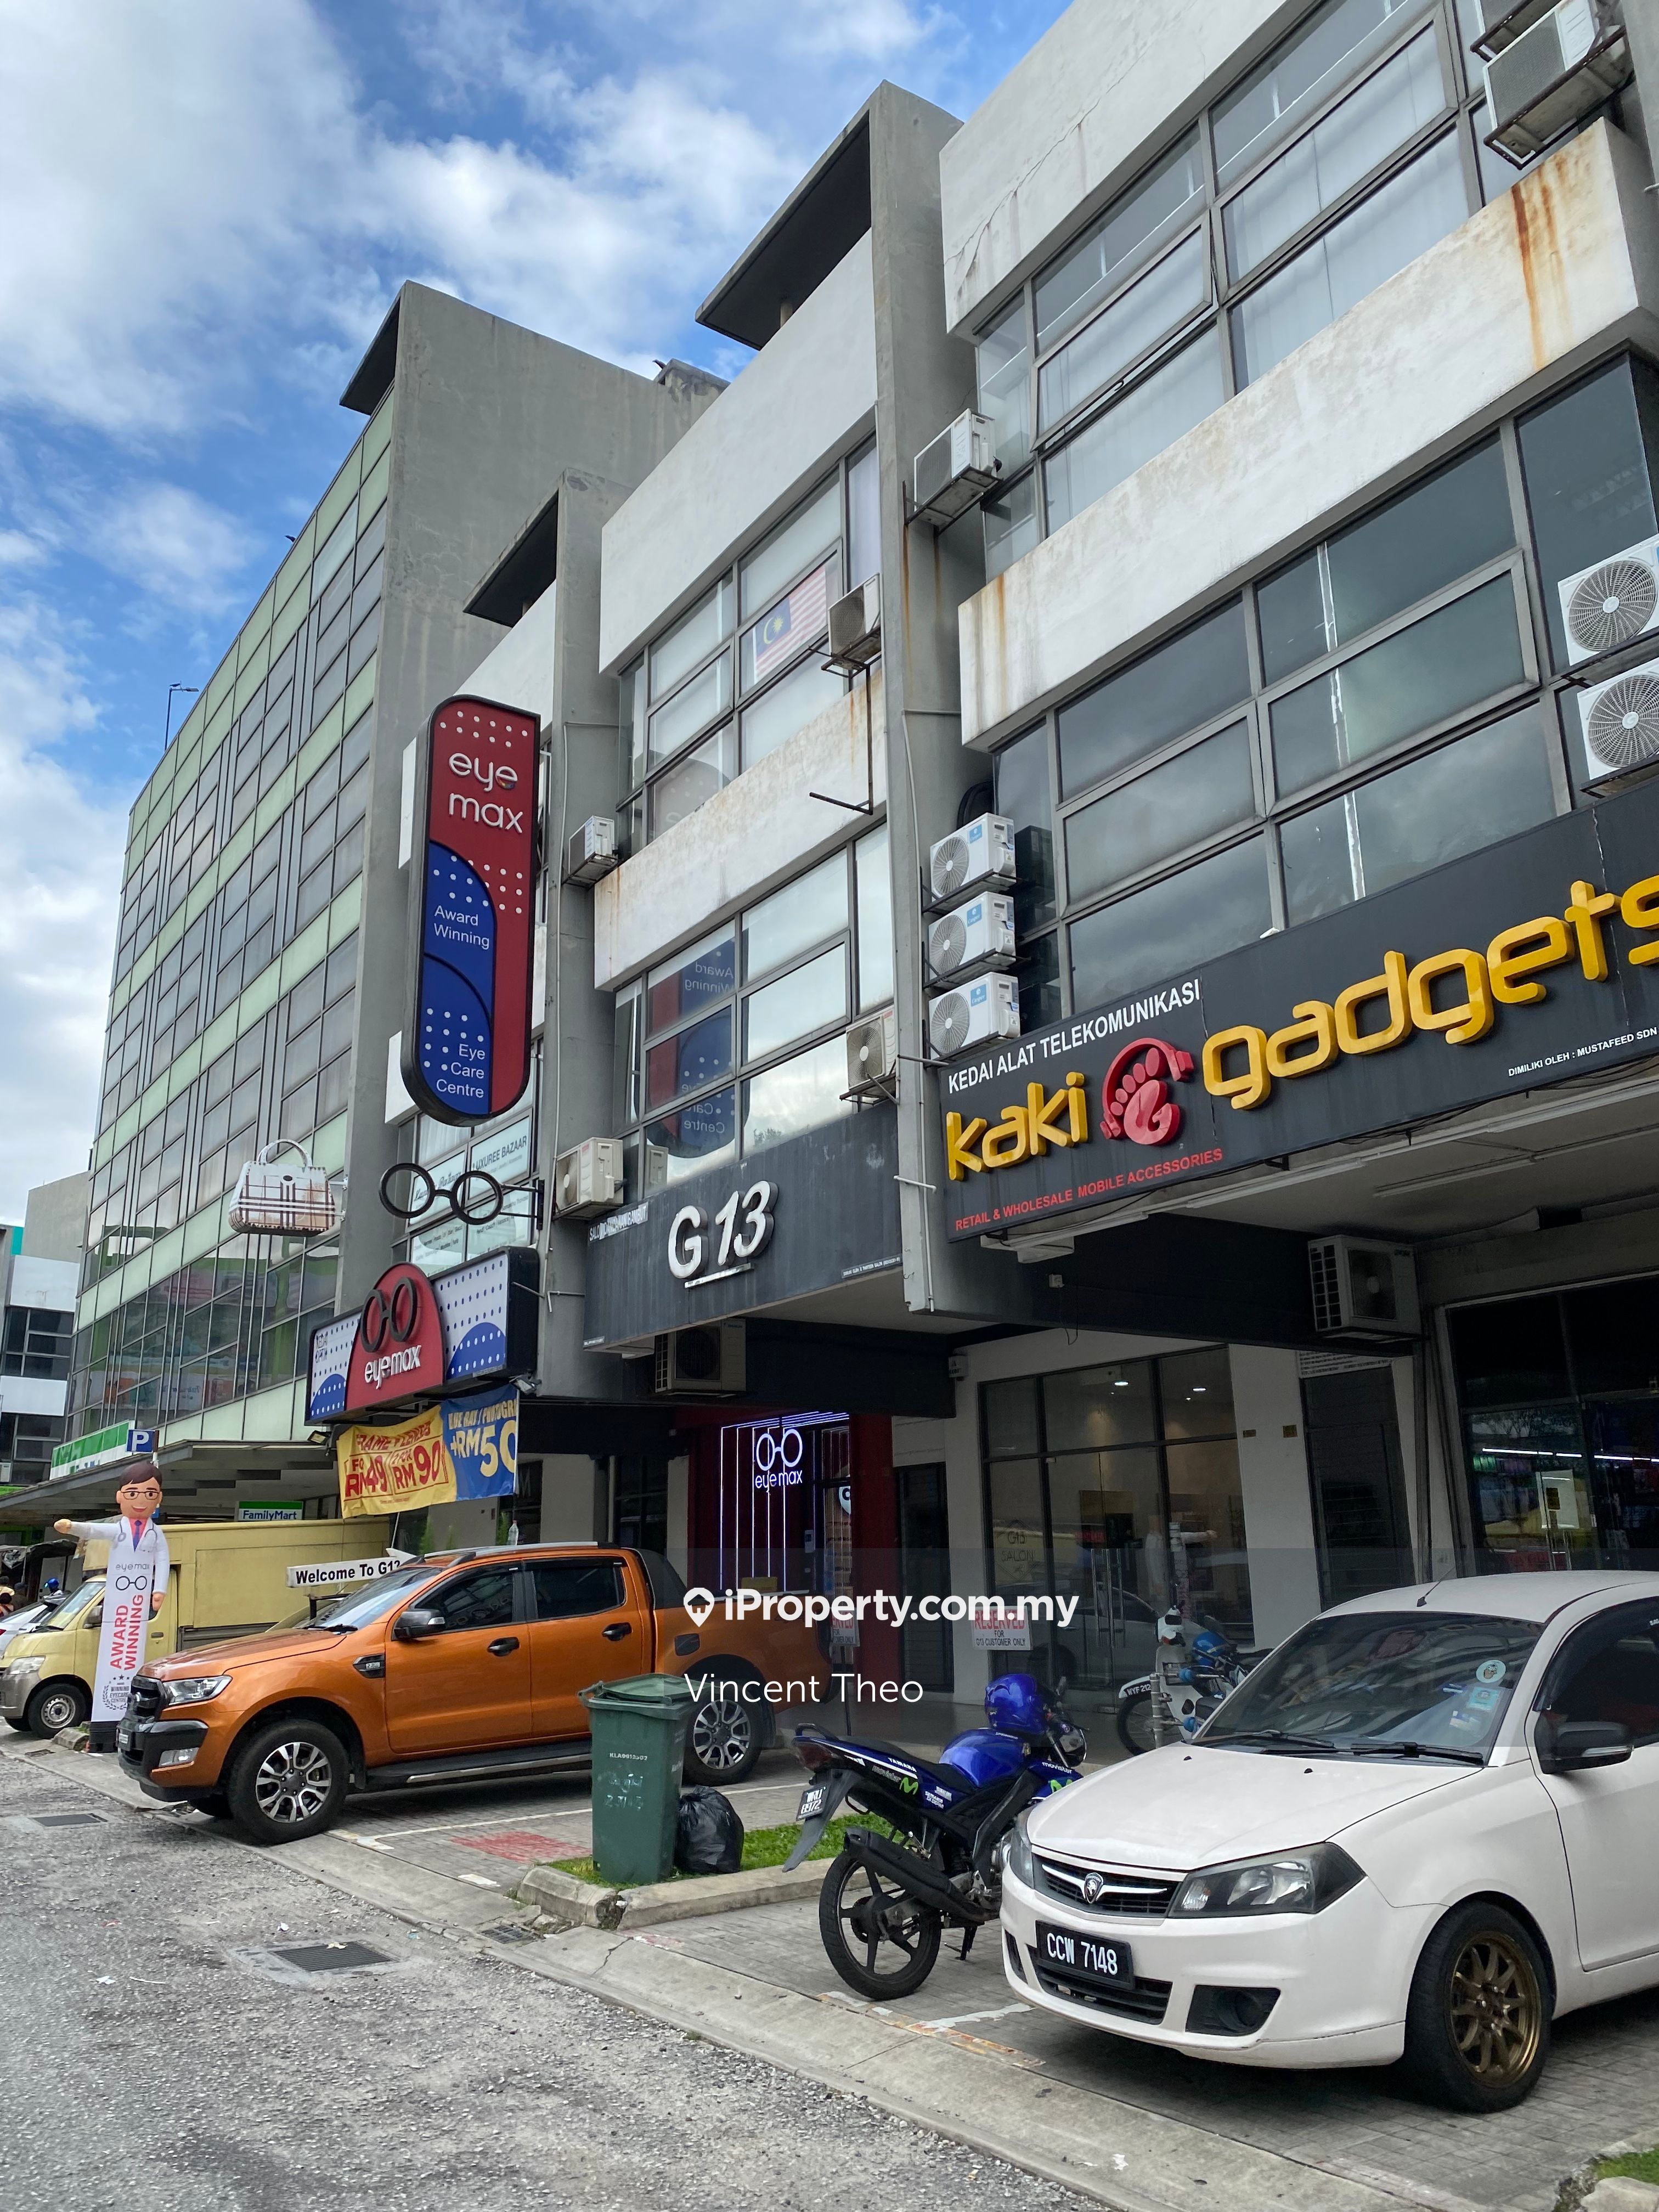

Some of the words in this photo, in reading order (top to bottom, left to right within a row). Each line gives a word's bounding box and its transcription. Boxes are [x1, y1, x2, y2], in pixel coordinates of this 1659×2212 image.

[449, 752, 518, 792] eye
[449, 793, 523, 833] max
[435, 905, 478, 926] Award
[434, 923, 490, 950] Winning
[949, 1059, 992, 1094] KEDAI
[996, 1042, 1036, 1076] ALAT
[1040, 979, 1200, 1059] TELEKOMUNIKASI
[459, 1043, 485, 1061] Eye
[1508, 1059, 1543, 1076] DIMILIKI
[1545, 1052, 1570, 1065] OLEH
[1577, 1034, 1634, 1058] MUSTAFEED
[1637, 1027, 1657, 1040] SDN
[451, 1062, 484, 1079] Care
[437, 1079, 484, 1098] Centre
[946, 1071, 1089, 1182] kaki
[501, 1135, 527, 1159] BAZAAR
[955, 1212, 991, 1232] RETAIL
[992, 1207, 1000, 1221] &
[1002, 1189, 1073, 1216] WHOLESALE
[1077, 1175, 1124, 1198] MOBILE
[1127, 1148, 1223, 1184] ACCESSORIES
[364, 1345, 422, 1390] eyemax
[132, 1431, 149, 1452] P
[242, 1510, 297, 1521] FamilyMart
[116, 1564, 150, 1573] eyemax
[296, 1568, 355, 1584] Welcome
[359, 1564, 374, 1577] To
[110, 1605, 129, 1670] AWARD
[124, 1594, 144, 1671] WINNING
[1042, 1762, 1073, 1774] movistar
[1047, 1933, 1074, 1964] CCW
[1080, 1941, 1118, 1976] 7148
